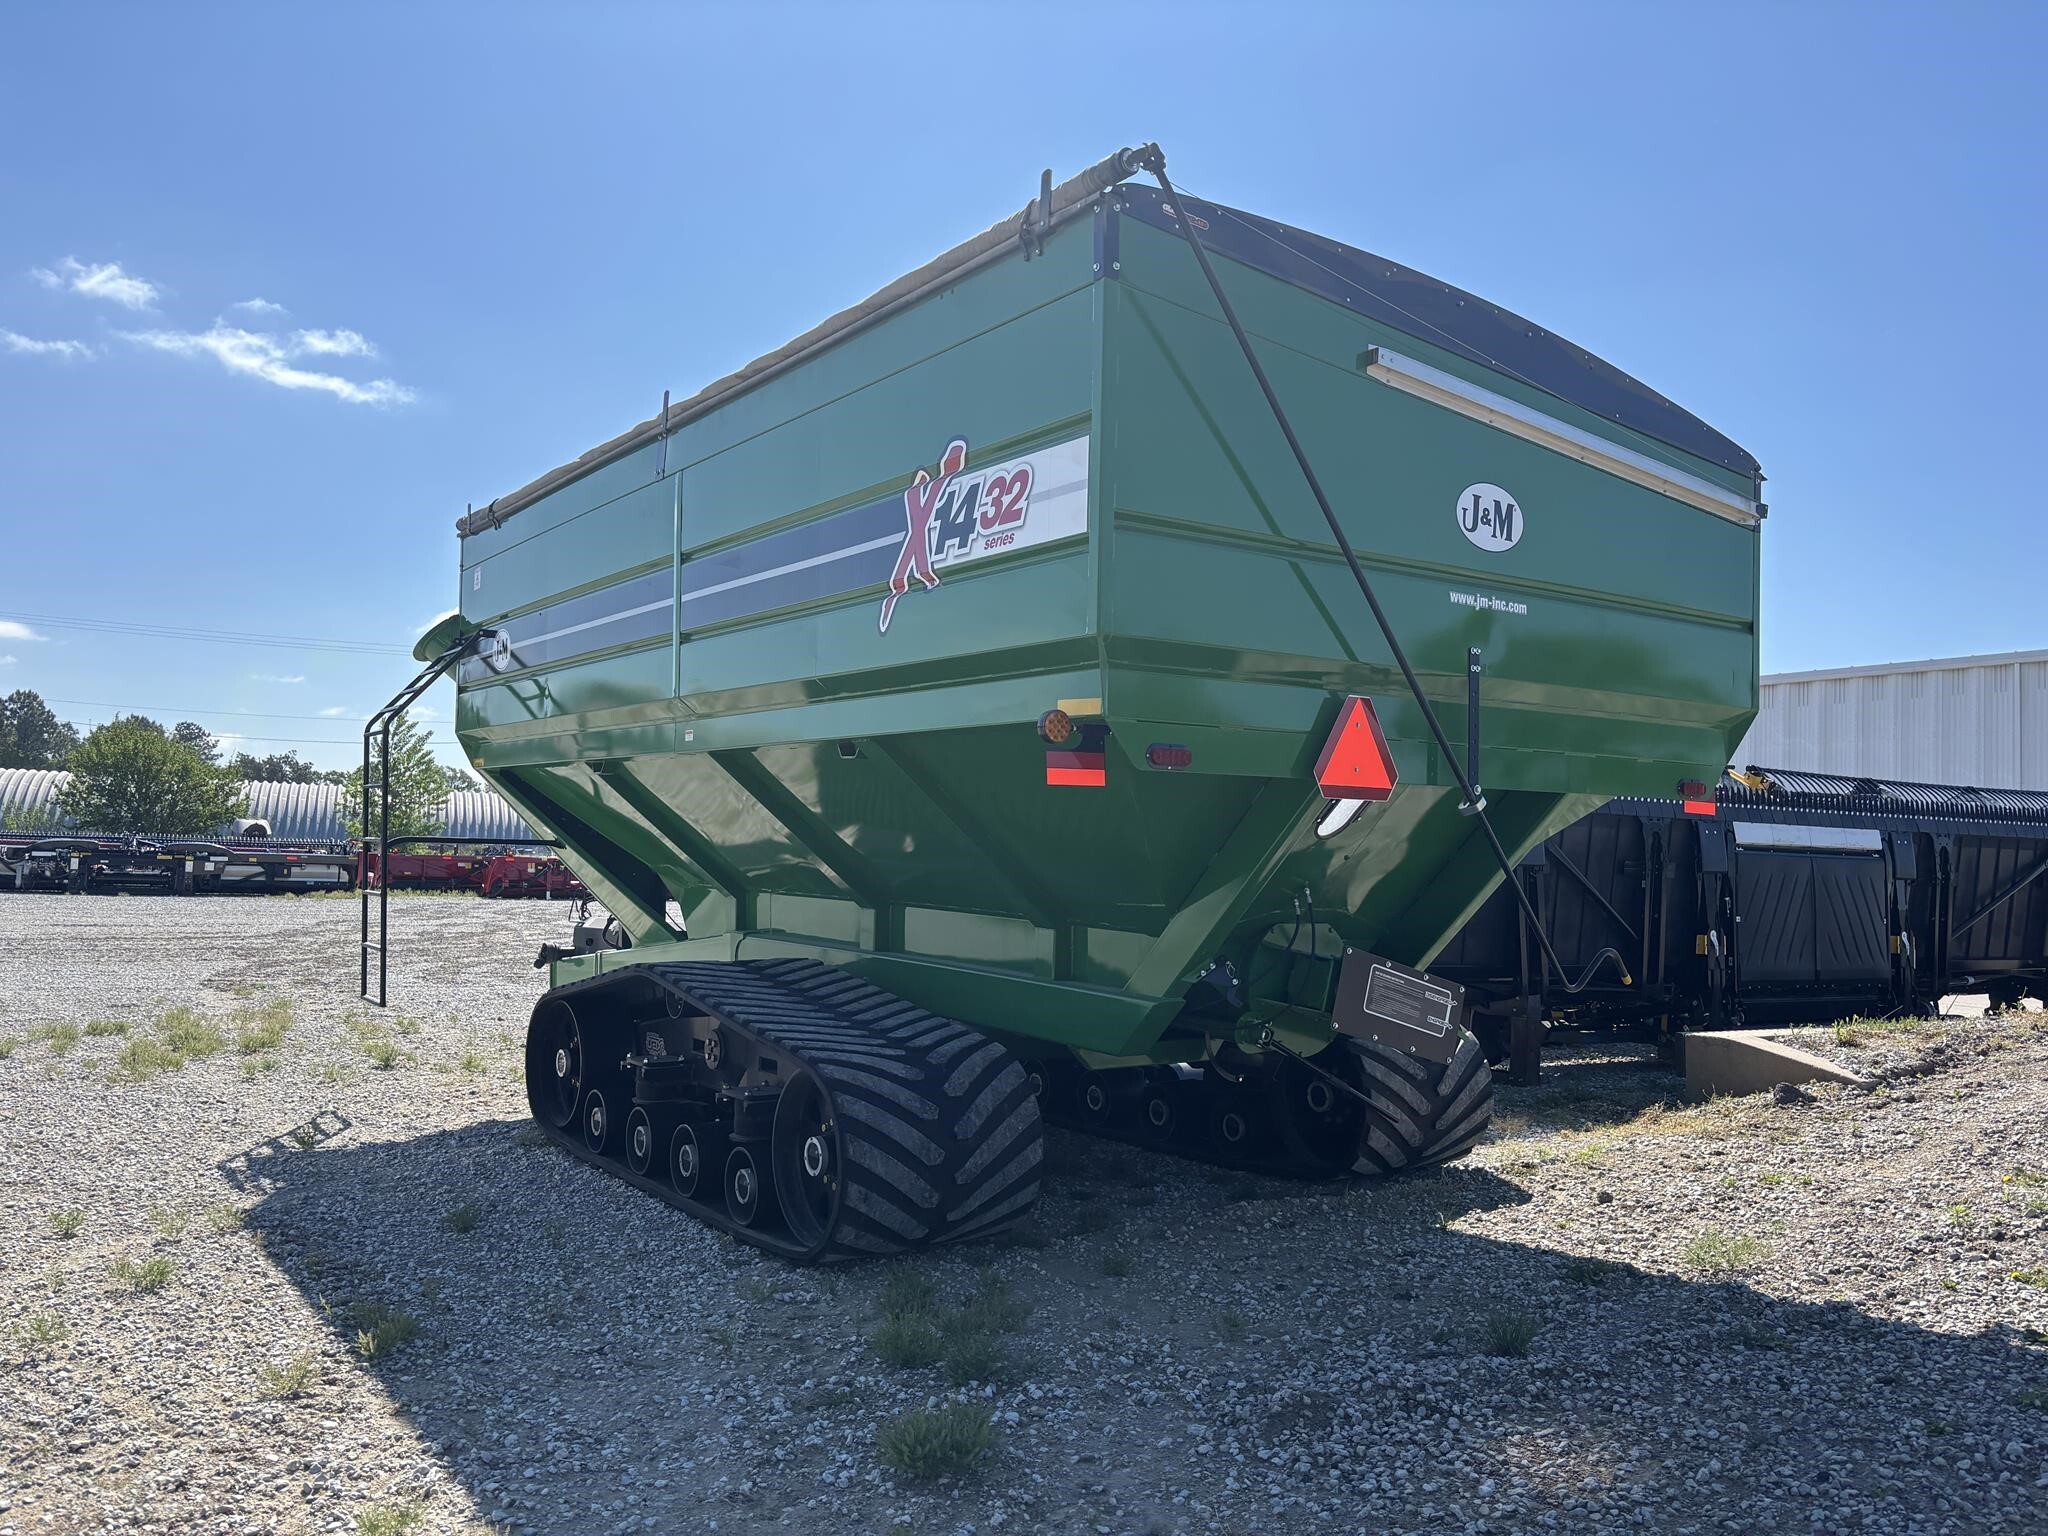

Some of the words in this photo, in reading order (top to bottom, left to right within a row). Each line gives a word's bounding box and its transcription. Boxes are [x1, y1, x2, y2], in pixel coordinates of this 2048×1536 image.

[1462, 494, 1515, 542] J&M
[984, 532, 1015, 550] series
[1450, 592, 1527, 615] www.jm-inc.com
